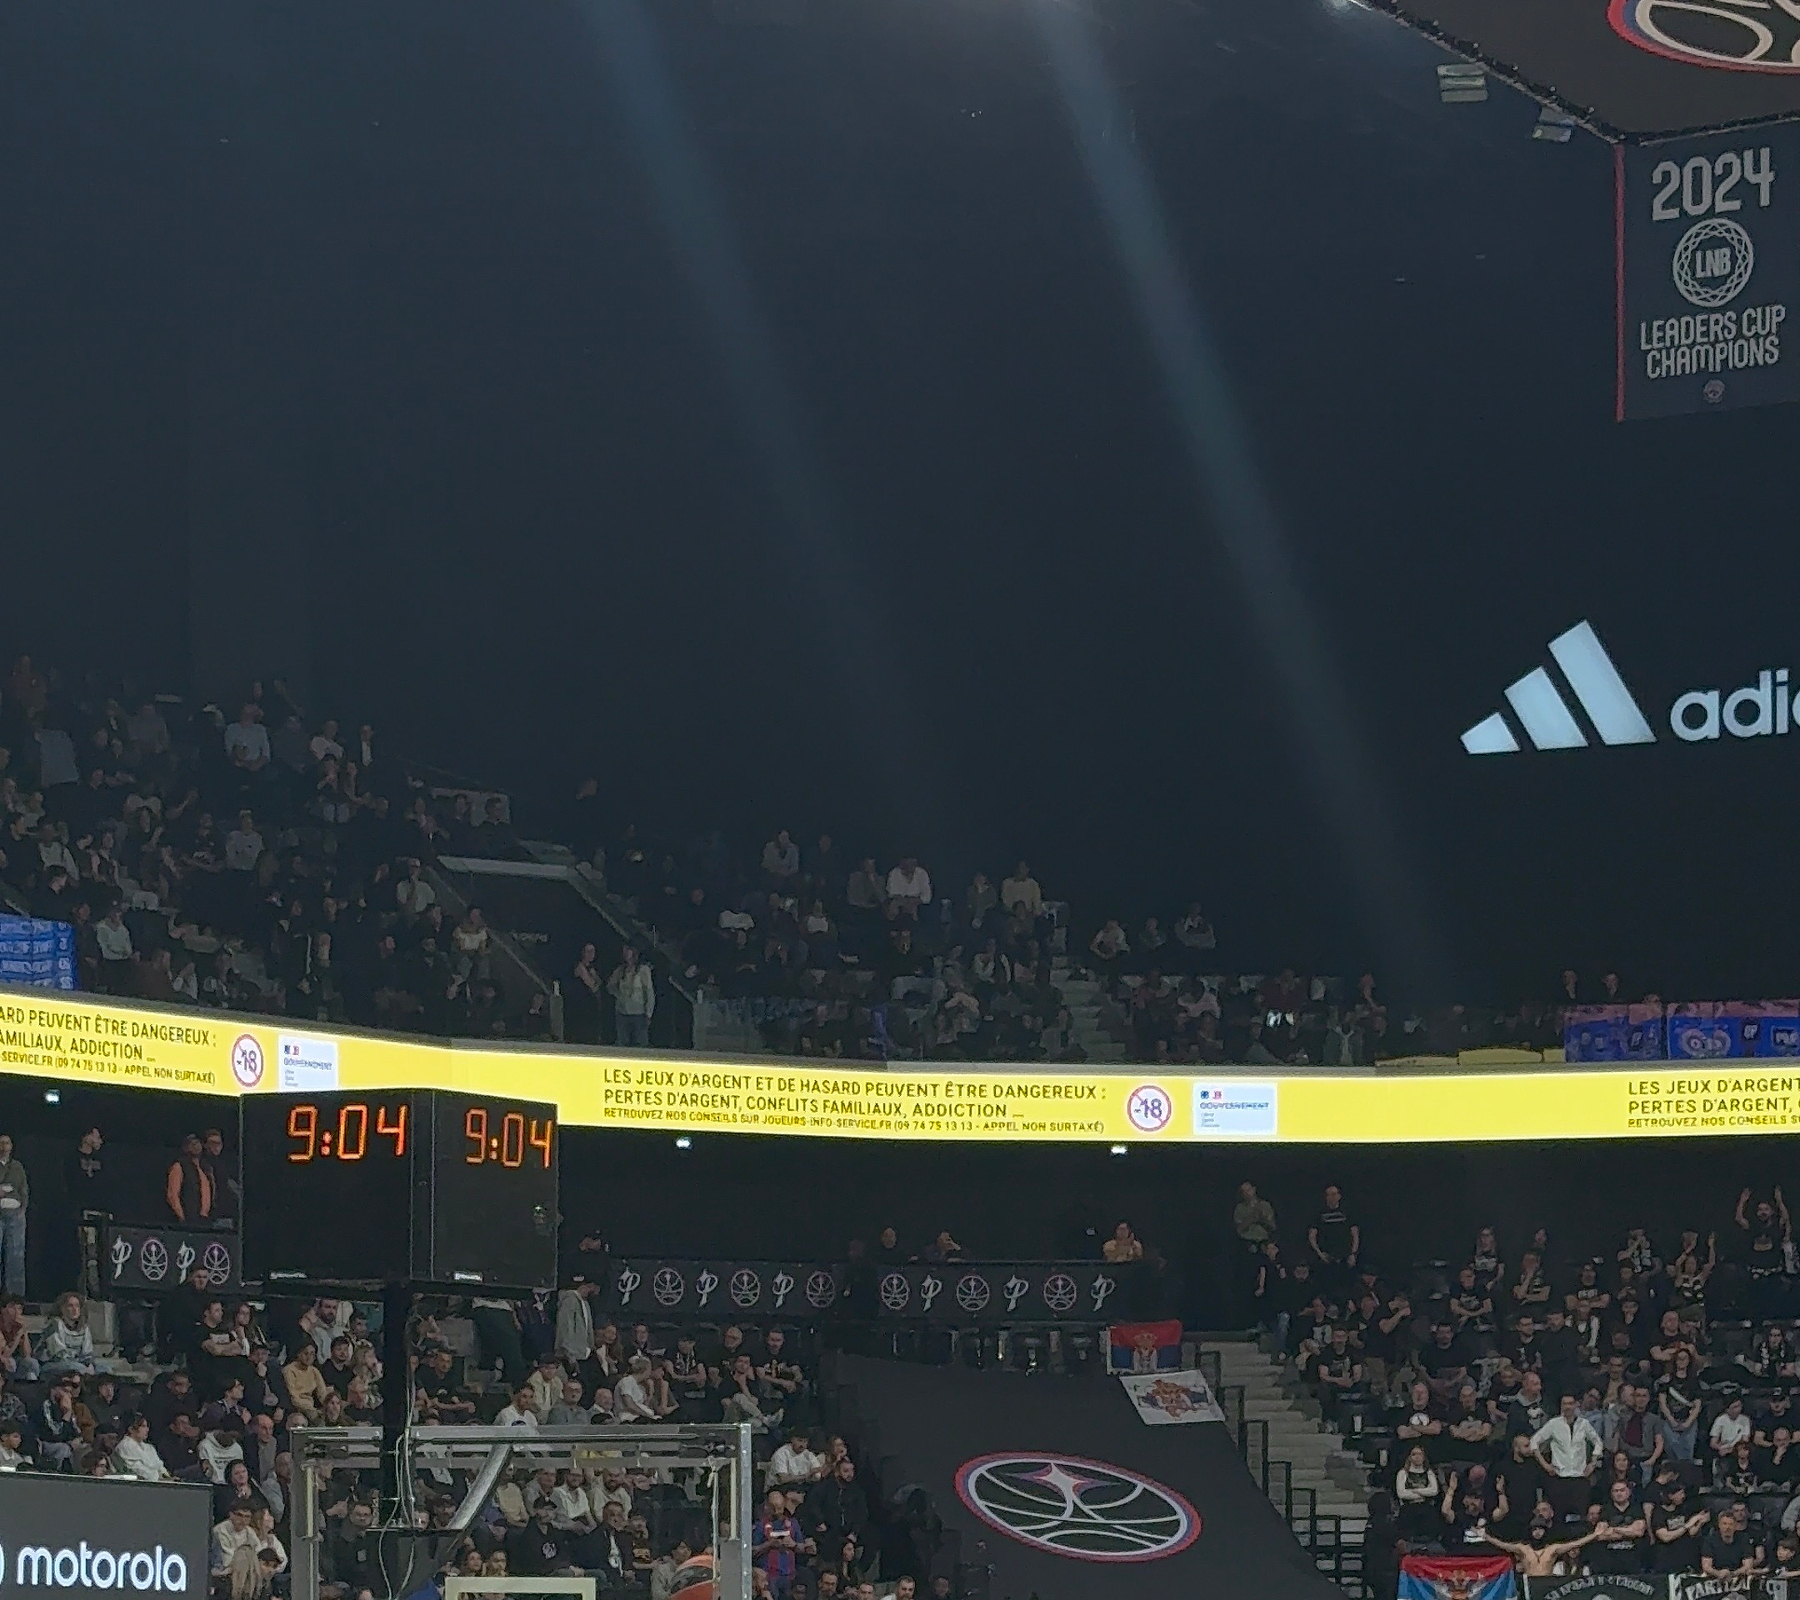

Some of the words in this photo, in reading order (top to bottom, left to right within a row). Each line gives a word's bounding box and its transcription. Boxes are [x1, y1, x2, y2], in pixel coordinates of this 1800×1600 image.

[1652, 147, 1775, 220] 2024
[1695, 248, 1731, 278] LNB
[1640, 310, 1737, 350] LEADERS
[1742, 304, 1786, 336] CUP
[1647, 335, 1779, 379] CHAMPIONS
[1670, 668, 1800, 742] adi
[29, 1009, 90, 1032] PEUVENT
[95, 1014, 128, 1036] ÊTRE
[132, 1022, 210, 1045] DANGEREUX
[70, 1038, 143, 1061] ADDICTION
[124, 1065, 151, 1078] APPEL
[154, 1067, 173, 1079] NON
[604, 1068, 632, 1085] LES
[636, 1070, 674, 1087] JEUX
[679, 1072, 752, 1091] D'ARGENT
[756, 1077, 772, 1092] ET
[778, 1078, 796, 1093] DE
[800, 1078, 861, 1096] HASARD
[865, 1082, 940, 1098] PEUVENT
[945, 1080, 988, 1099] ÊTRE
[993, 1084, 1097, 1100] DANGEREUX
[1628, 1081, 1660, 1095] LES
[1666, 1080, 1711, 1094] JEUX
[604, 1089, 663, 1106] PERTES
[667, 1092, 743, 1113] D'ARGENT,
[746, 1095, 818, 1113] CONFLITS
[823, 1099, 907, 1119] FAMILIAUX,
[912, 1103, 1007, 1118] ADDICTION
[604, 1108, 663, 1120] RETROUVEZ
[666, 1111, 687, 1121] NOS
[689, 1112, 737, 1123] CONSEILS
[740, 1114, 760, 1124] SUR
[1022, 1122, 1046, 1132] NON
[1628, 1099, 1696, 1114] PERTES
[1703, 1097, 1792, 1113] D'ARGENT,
[287, 1103, 410, 1161] 9:04
[465, 1107, 552, 1168] 9:04
[1628, 1117, 1697, 1128] RETROUVEZ
[1701, 1116, 1725, 1126] NOS
[1729, 1115, 1787, 1125] CONSEILS
[17, 1541, 187, 1592] motorola
